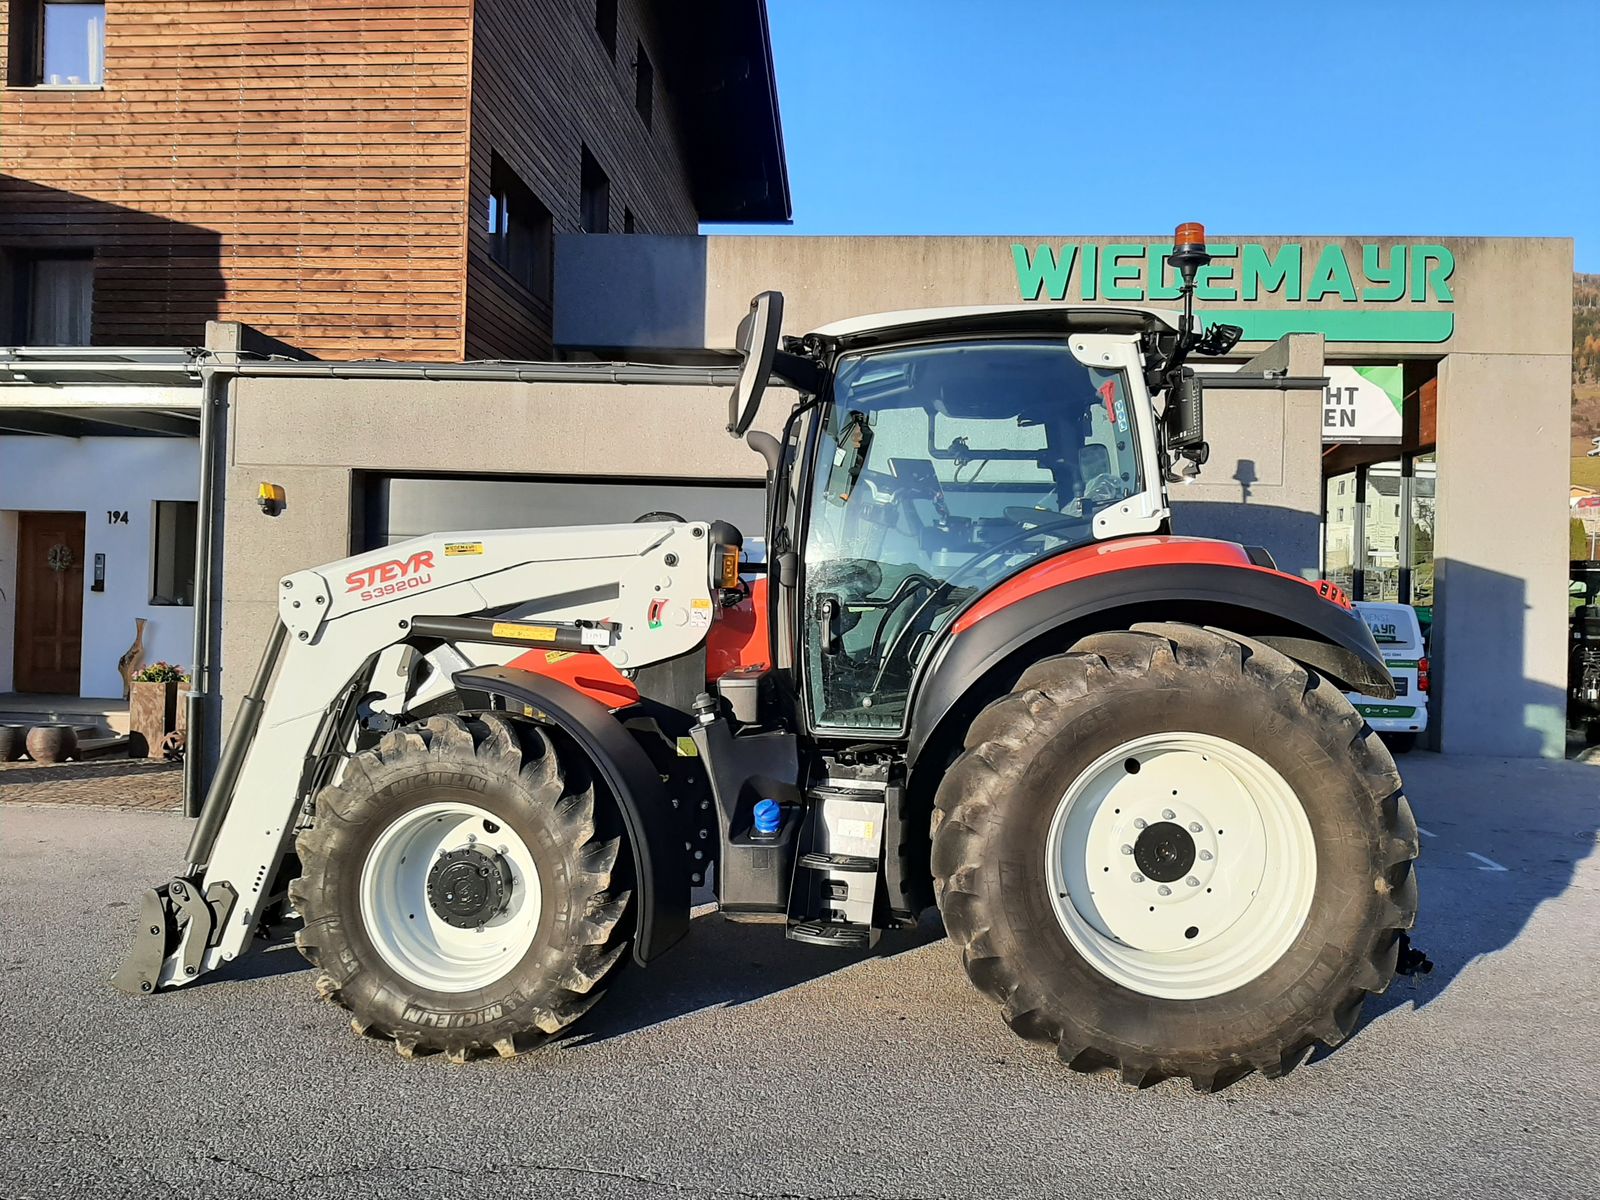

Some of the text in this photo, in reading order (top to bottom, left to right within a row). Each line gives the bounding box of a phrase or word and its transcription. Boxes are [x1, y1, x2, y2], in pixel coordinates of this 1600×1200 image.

[1012, 244, 1456, 302] WIEDEMAYR
[107, 510, 129, 525] 194
[345, 550, 435, 593] STEYR
[361, 573, 431, 601] S3920U
[391, 771, 488, 795] MICHELIN
